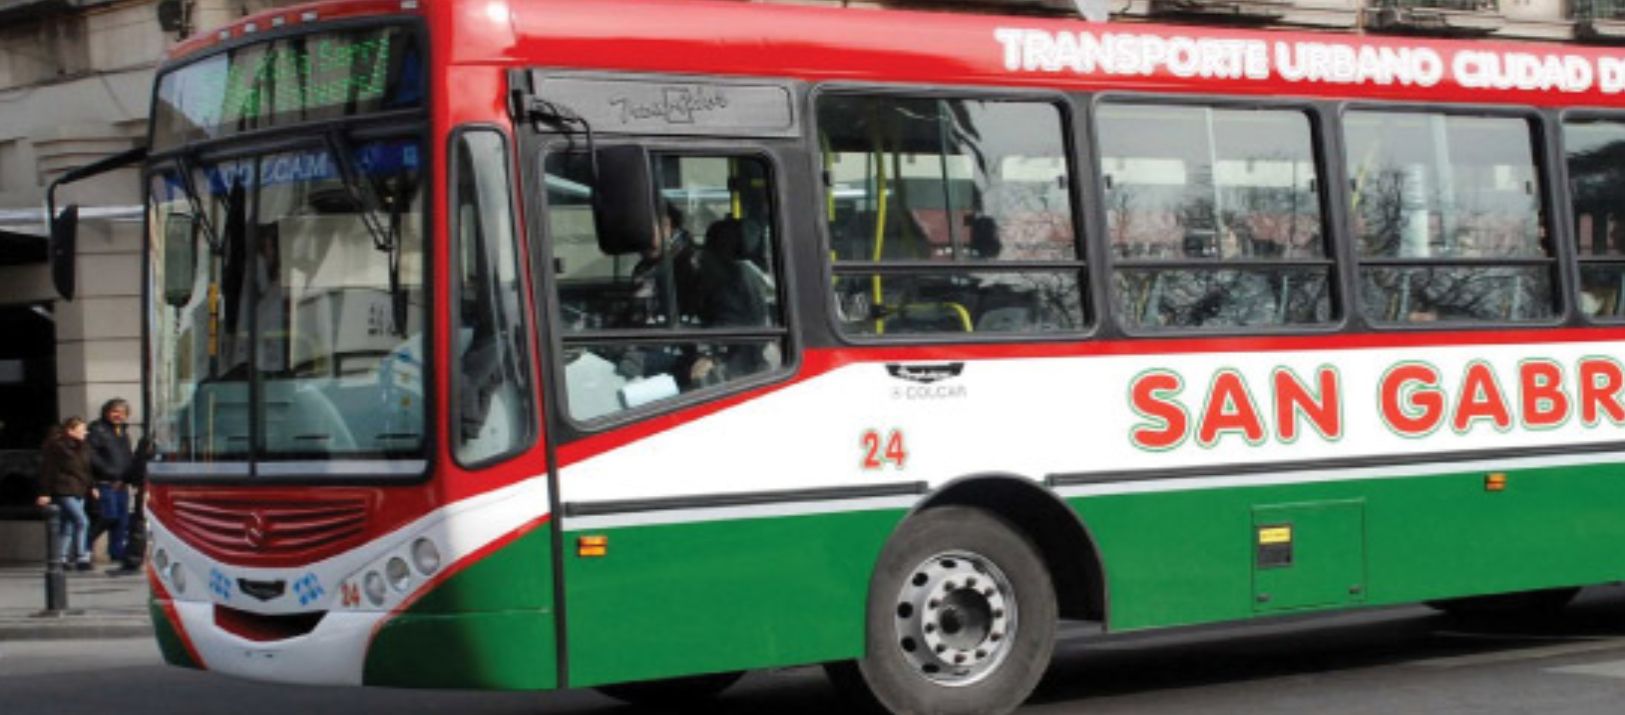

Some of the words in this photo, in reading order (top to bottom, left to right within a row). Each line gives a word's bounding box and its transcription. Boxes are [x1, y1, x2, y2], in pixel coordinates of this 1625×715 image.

[994, 27, 1269, 80] TRANSPORTE
[1274, 41, 1444, 88] URBANO
[1452, 50, 1594, 93] CIUDAD
[1130, 366, 1343, 453] SAN
[1376, 355, 1625, 439] GABR
[861, 428, 908, 470] 24
[340, 582, 361, 607] 24
